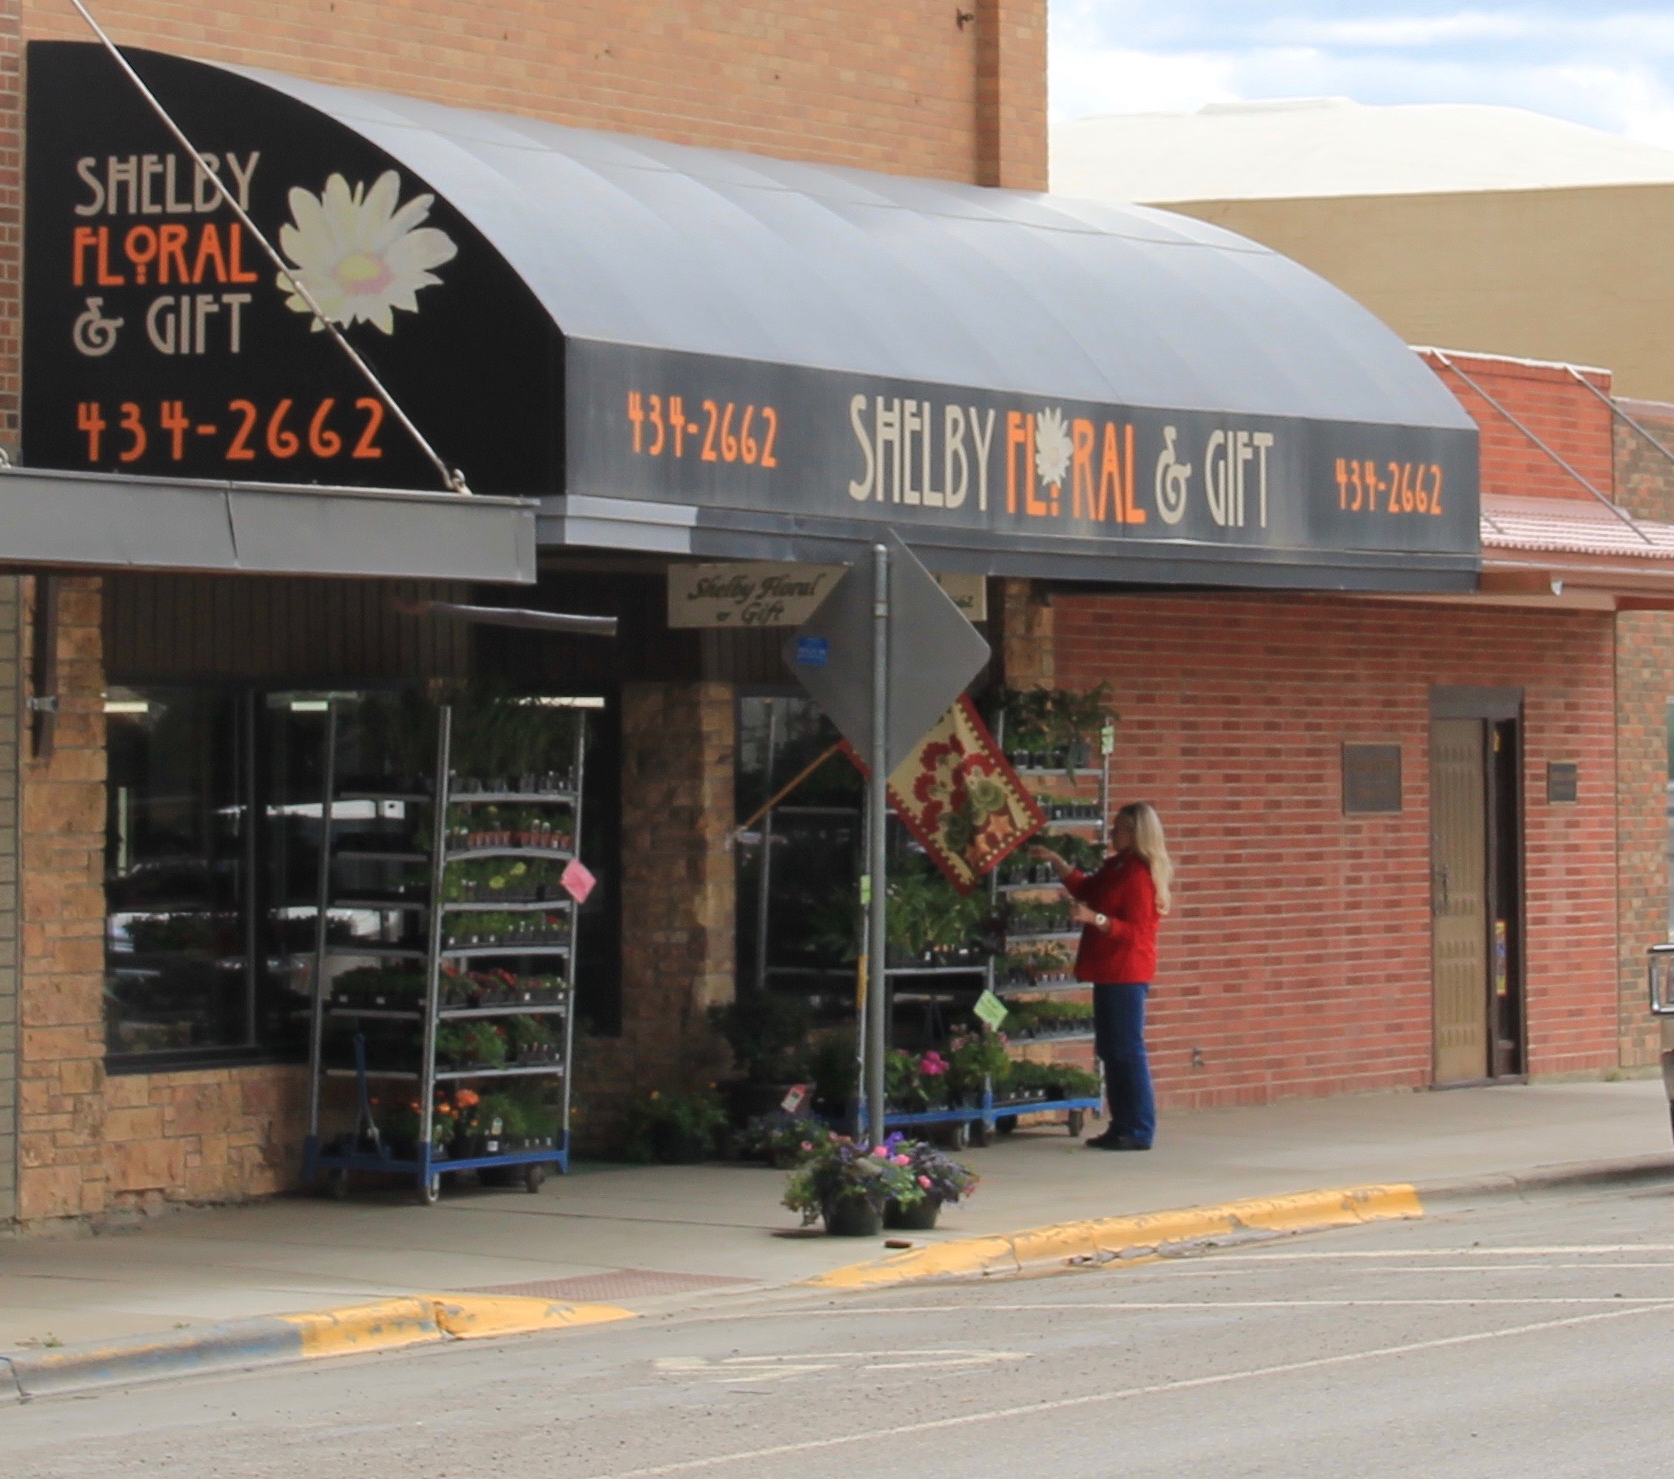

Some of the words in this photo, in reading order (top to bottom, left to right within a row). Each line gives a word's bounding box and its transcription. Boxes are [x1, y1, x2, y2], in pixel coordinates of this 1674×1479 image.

[74, 151, 260, 216] SHELBY
[73, 223, 257, 286] FLORAL
[73, 297, 124, 357] &
[146, 293, 251, 354] GIFT
[77, 398, 385, 462] 434-2662
[628, 390, 778, 469] 434-2662
[849, 394, 996, 513] SHELBY
[1006, 406, 1147, 525] FLRAL
[1155, 425, 1192, 524] &
[1205, 429, 1274, 528] GIFT
[1335, 457, 1443, 516] 434-2662
